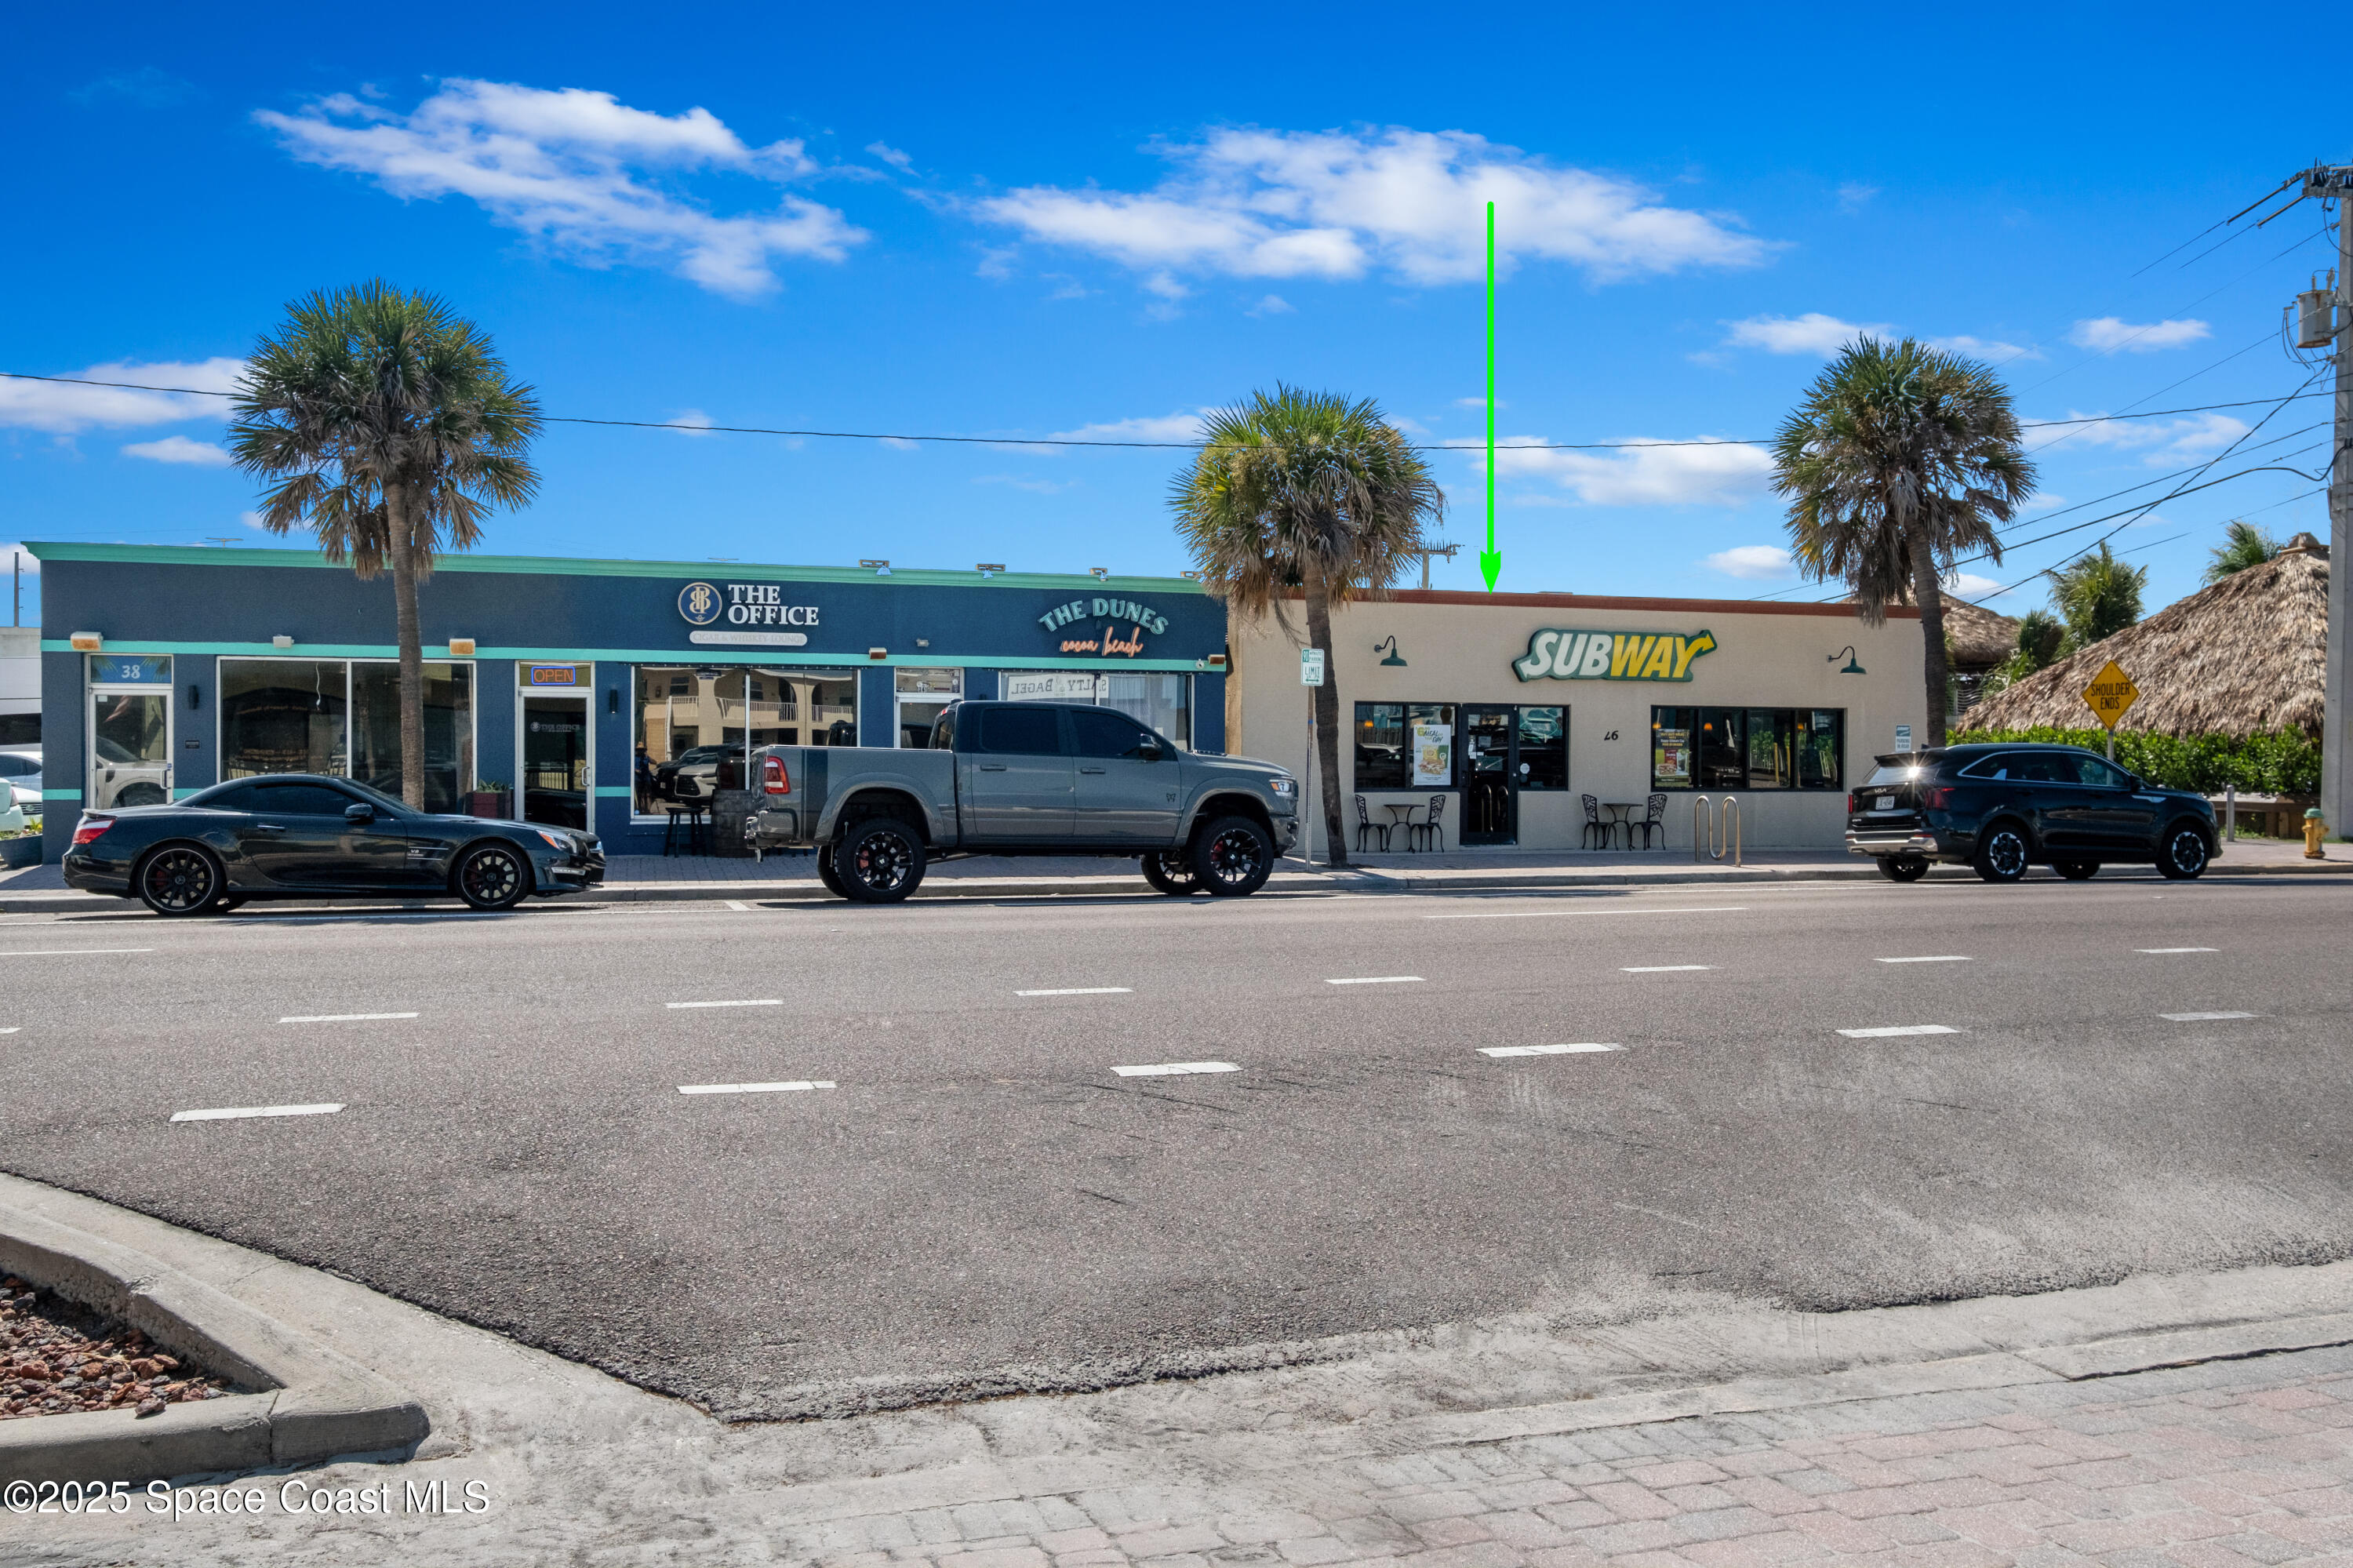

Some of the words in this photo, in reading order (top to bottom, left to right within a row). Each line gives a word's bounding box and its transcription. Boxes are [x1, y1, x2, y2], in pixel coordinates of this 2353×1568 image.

[728, 584, 781, 605] THE
[728, 605, 820, 626] OFFICE
[1038, 600, 1087, 632] THE
[1093, 598, 1169, 635] DUNES
[693, 633, 720, 642] CIGAR
[729, 634, 768, 643] WHISKEY
[771, 635, 805, 644] LOUNGE
[1060, 638, 1099, 653] cocoa
[1102, 626, 1144, 658] beach
[1304, 650, 1309, 662] 90
[1518, 631, 1715, 680] SUBWAY
[122, 664, 140, 678] 38
[533, 668, 573, 683] OPEN
[1305, 667, 1320, 678] LIMIT
[2091, 683, 2130, 697] SHOULDER
[2100, 697, 2119, 709] ENDS
